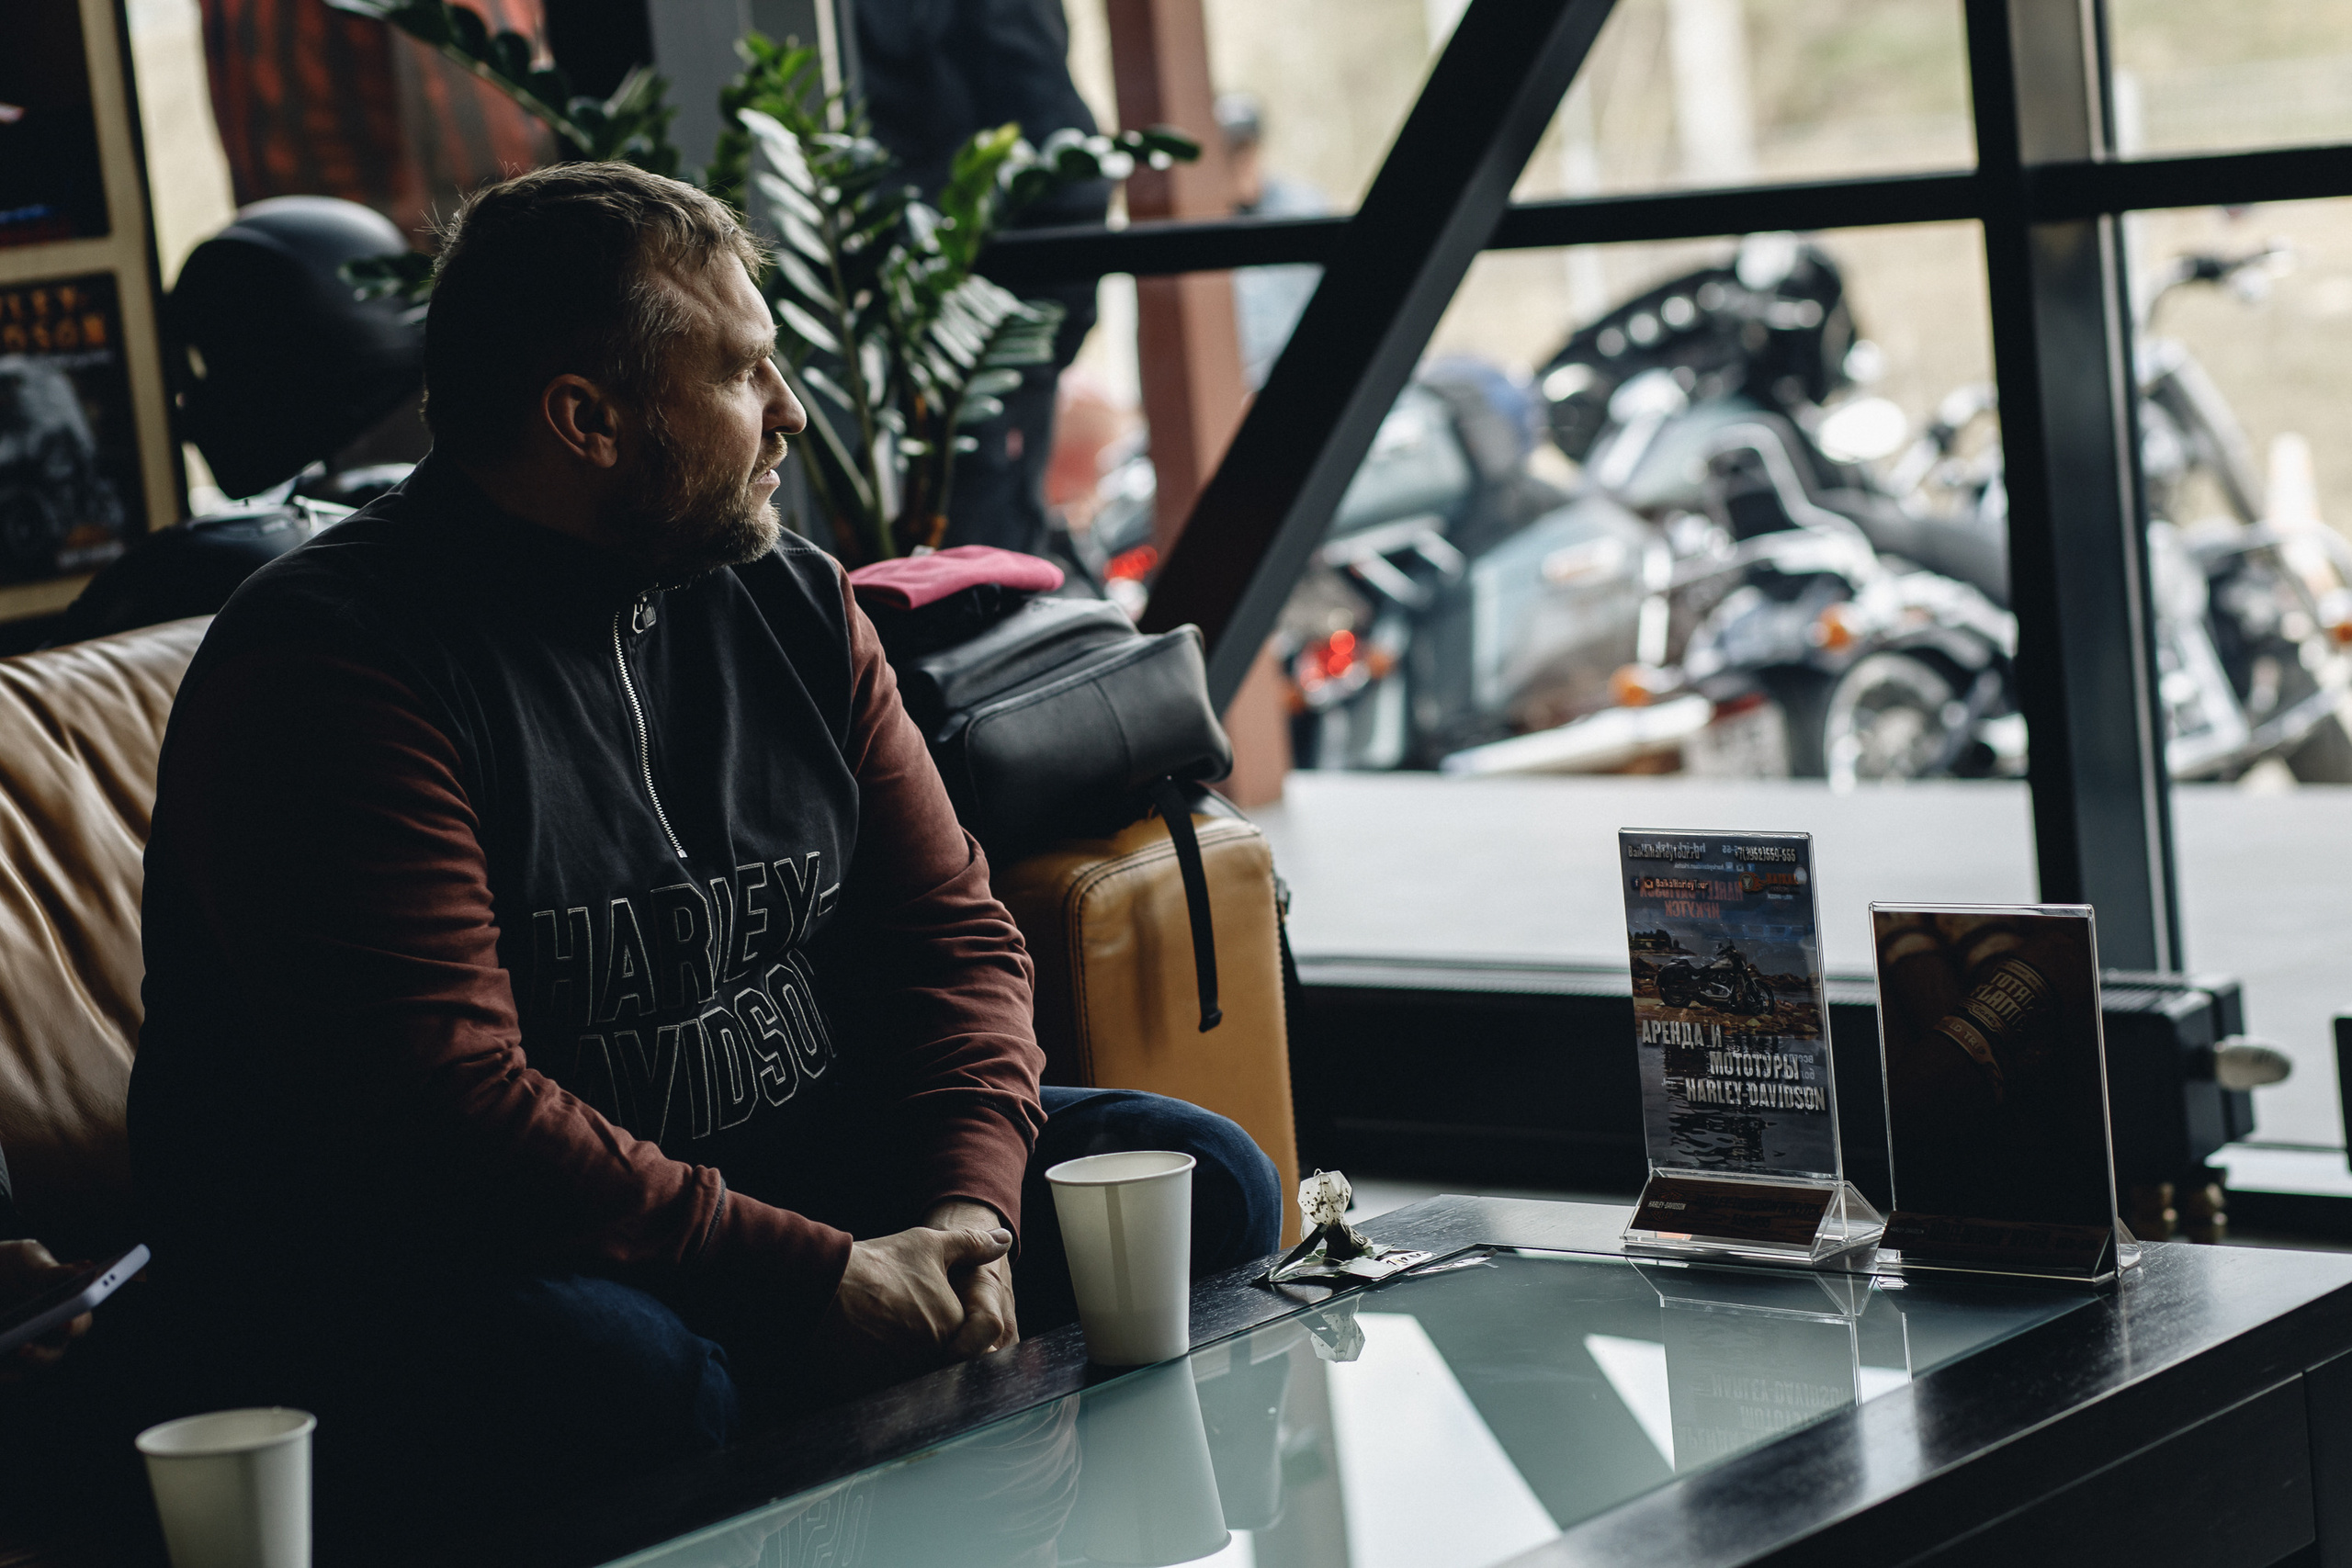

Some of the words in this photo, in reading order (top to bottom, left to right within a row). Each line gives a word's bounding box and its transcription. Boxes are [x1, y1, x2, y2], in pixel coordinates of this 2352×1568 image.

[1642, 1020, 1704, 1049] АРЕНДА
[1710, 1023, 1723, 1048] И
[1709, 1050, 1800, 1081] МОТОТУРЫ
[1685, 1077, 1826, 1111] HARLEY-DAVIDSON
